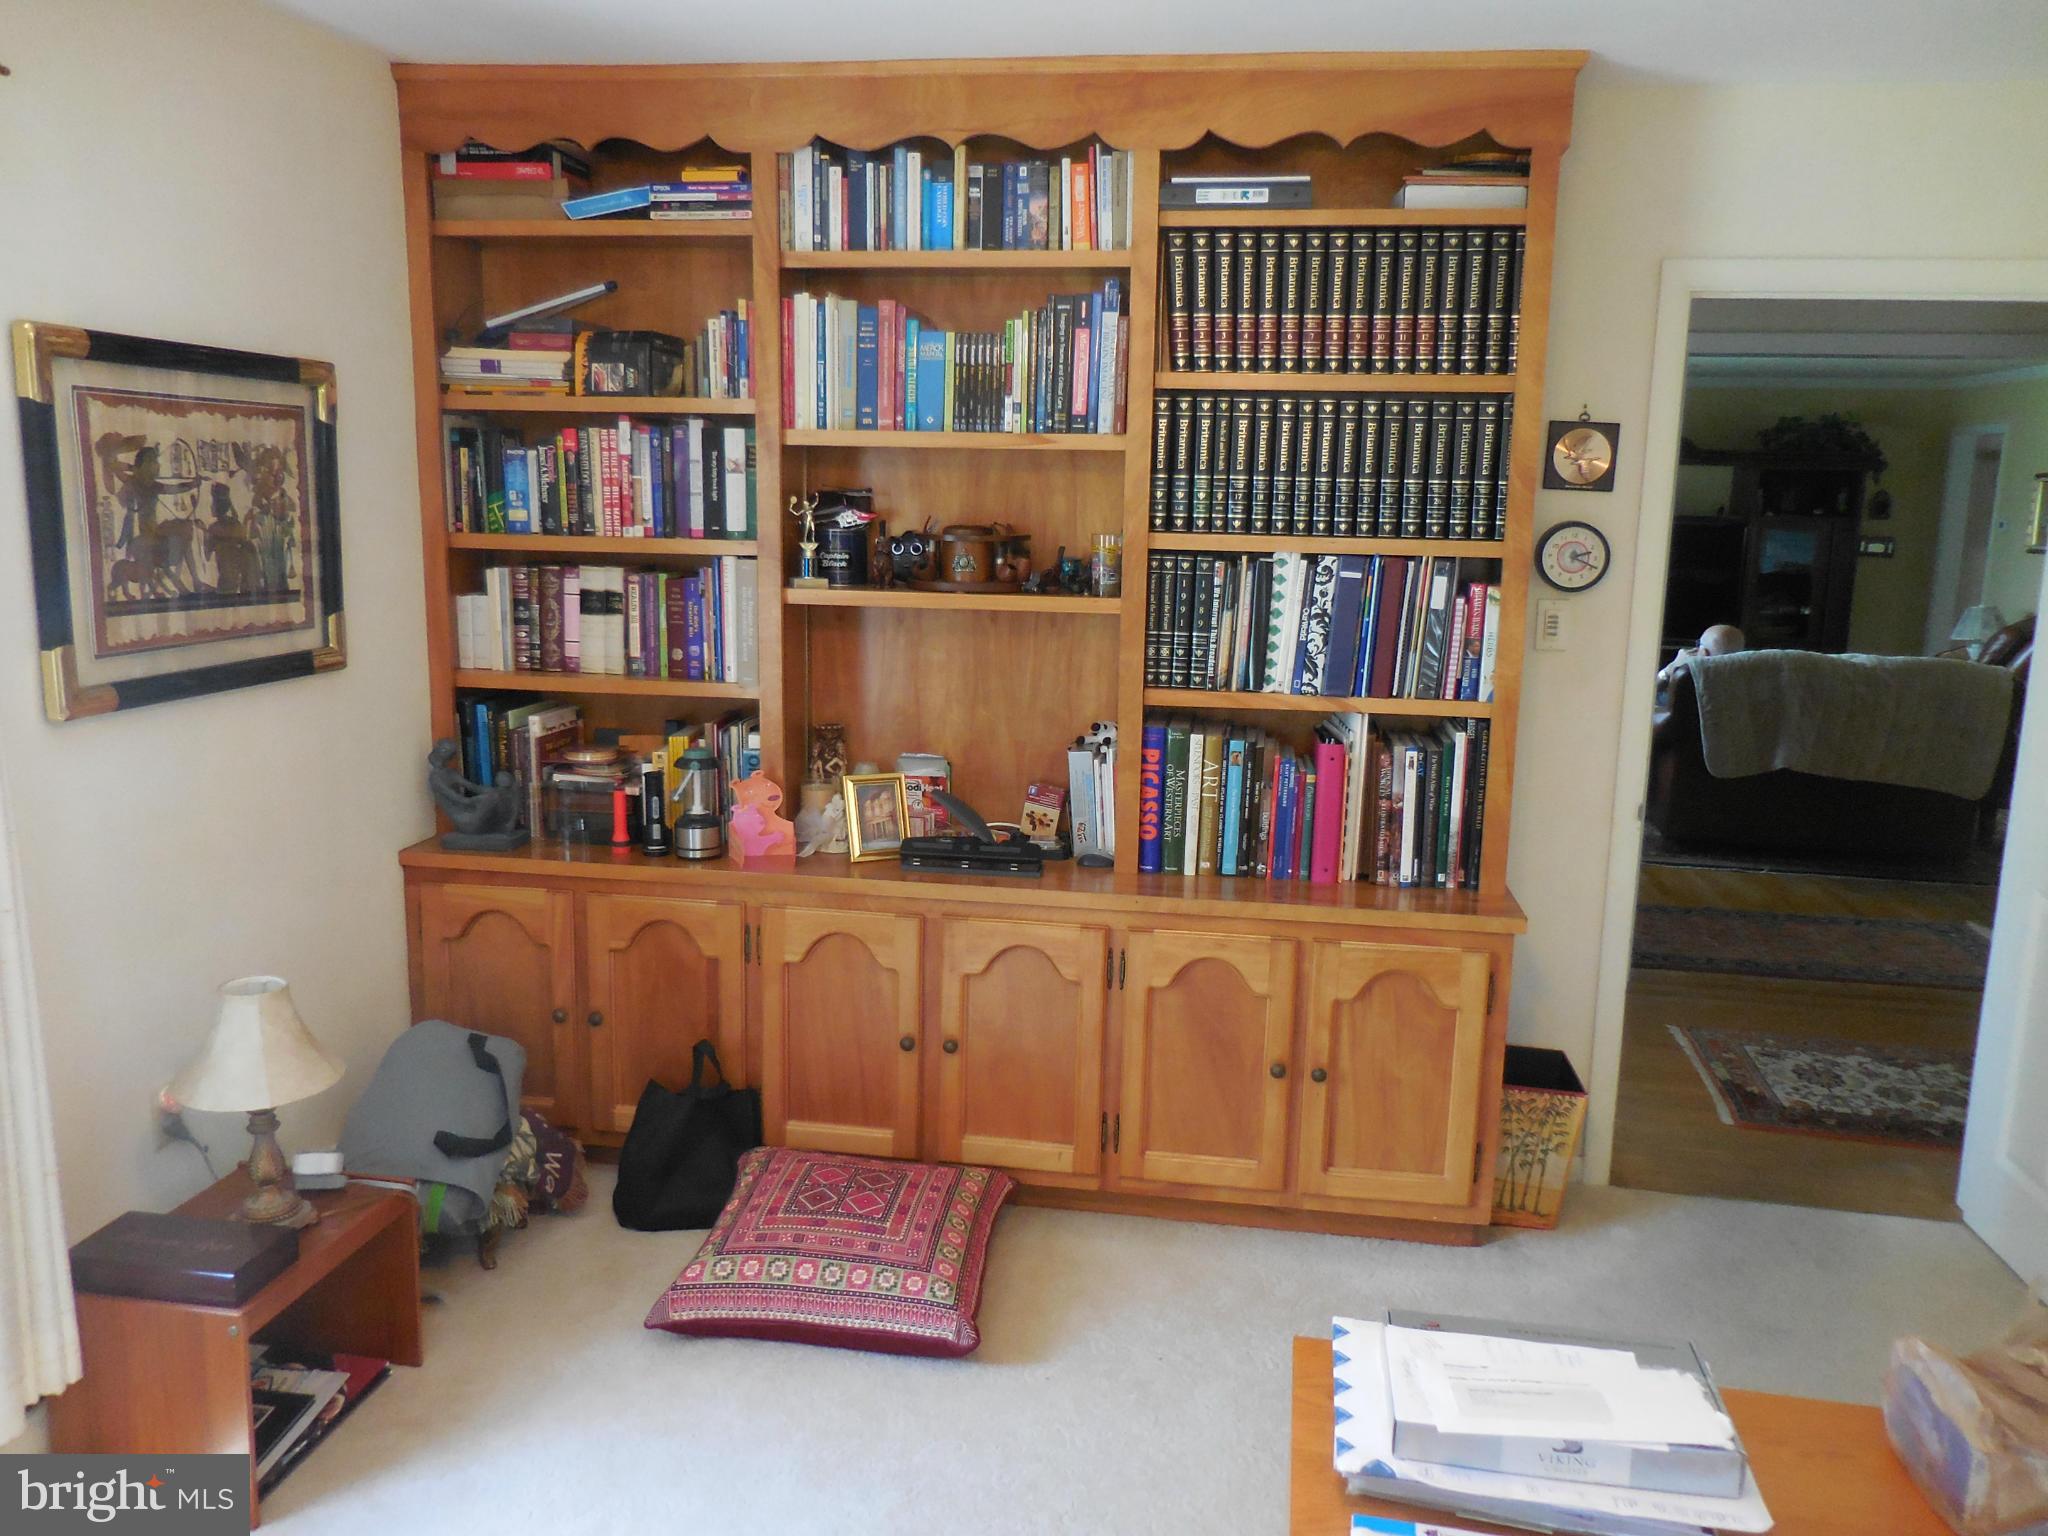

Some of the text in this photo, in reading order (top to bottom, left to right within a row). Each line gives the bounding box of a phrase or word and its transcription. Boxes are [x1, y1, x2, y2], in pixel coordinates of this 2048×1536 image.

[1175, 256, 1184, 308] Britannica
[1198, 256, 1207, 308] Britannica
[1221, 257, 1230, 309] Britannica
[1243, 257, 1253, 309] Britannica
[1265, 257, 1275, 309] Britannica
[1288, 257, 1298, 309] Britannica
[1310, 257, 1321, 309] Britannica
[1333, 257, 1345, 309] Britannica
[1355, 257, 1367, 309] Britannica
[1379, 257, 1390, 309] Britannica
[1401, 257, 1413, 309] Britannica
[1423, 256, 1436, 309] Britannica
[1446, 256, 1458, 309] Britannica
[1469, 256, 1482, 309] Britannica
[1495, 256, 1507, 309] Britannica
[1156, 419, 1167, 468] Britannica
[1177, 419, 1189, 469] Britannica
[1199, 419, 1210, 470] Britannica
[1236, 420, 1247, 470] Britannica
[1258, 420, 1268, 471] Britannica
[1280, 421, 1291, 471] Britannica
[1300, 421, 1311, 472] Britannica
[1321, 421, 1332, 472] Britannica
[1343, 423, 1354, 473] Britannica
[1365, 423, 1377, 473] Britannica
[1388, 423, 1400, 474] Britannica
[1412, 423, 1424, 474] Britannica
[1435, 423, 1448, 474] Britannica
[1459, 424, 1471, 474] Britannica
[1482, 424, 1494, 475] Britannica
[600, 429, 613, 536] NEW RULES BILL MAHER
[609, 429, 621, 536] NEW RULES BILL MAHER
[820, 552, 849, 560] Captain
[1211, 599, 1219, 628] Interrupt
[1213, 587, 1221, 598] We
[1300, 607, 1309, 641] OurWorld
[1207, 644, 1217, 677] Broadcast
[1202, 760, 1219, 802] ART
[1430, 763, 1438, 778] World
[1431, 755, 1439, 763] The
[906, 783, 943, 793] odiHeat
[1140, 749, 1161, 840] PICASSO
[1163, 764, 1175, 842] OF WESTERN ART
[1173, 769, 1185, 838] MASTERPIECES
[1259, 812, 1270, 841] buildings
[1475, 805, 1483, 829] WORLD
[1537, 1452, 1597, 1469] VIKING
